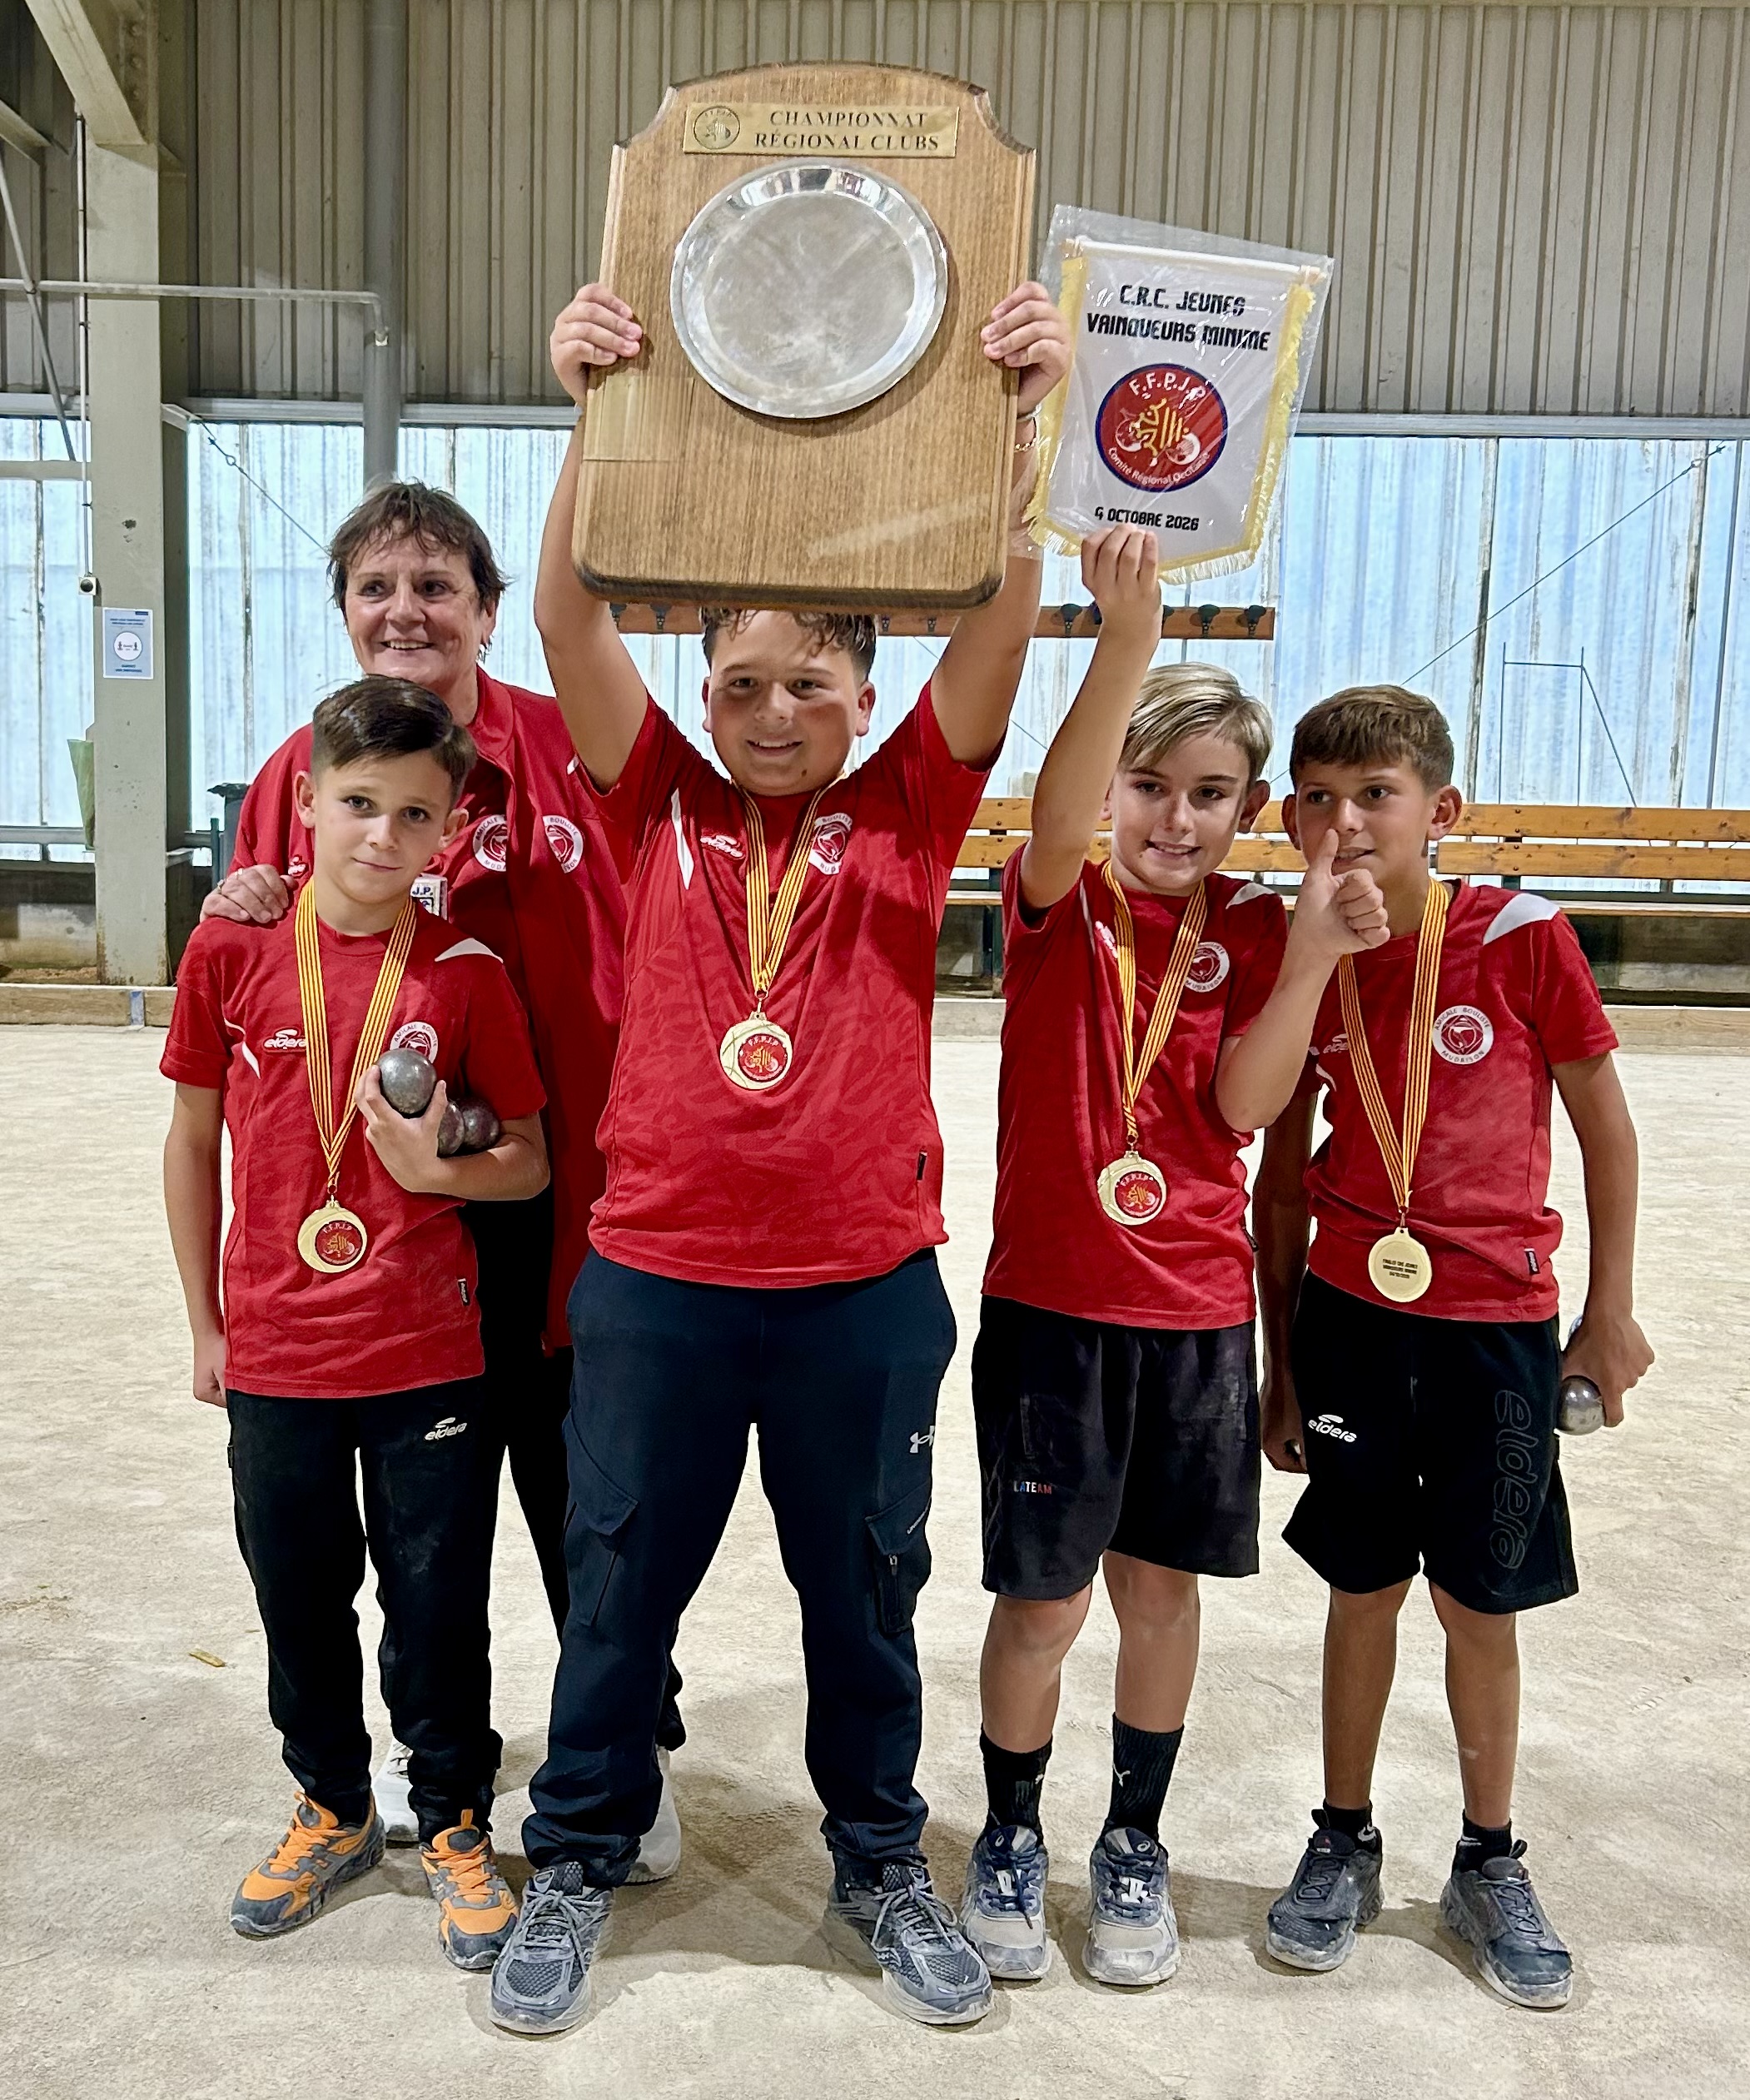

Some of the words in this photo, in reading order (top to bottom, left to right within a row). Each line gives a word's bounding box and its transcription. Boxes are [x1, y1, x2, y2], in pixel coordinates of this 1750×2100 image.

[769, 110, 928, 129] CHAMPIONNAT
[753, 129, 866, 151] RÉGIONAL
[870, 136, 939, 152] CLUBS
[1119, 284, 1170, 309] C.R.C.
[1176, 291, 1246, 317] JEUNES
[1086, 312, 1197, 343] VAINQUEURS
[1201, 324, 1272, 351] MINIME
[1108, 446, 1133, 476] Comité
[1131, 468, 1171, 486] Régional
[1094, 505, 1104, 520] 4
[1107, 507, 1163, 528] OCTOBRE
[1166, 515, 1200, 531] 2026
[1434, 1008, 1458, 1031] AMICALE
[1463, 1007, 1491, 1028] BOULISTE
[1440, 1050, 1485, 1063] MUDAISON
[1308, 1417, 1357, 1443] eldera
[1489, 1389, 1539, 1570] eldera
